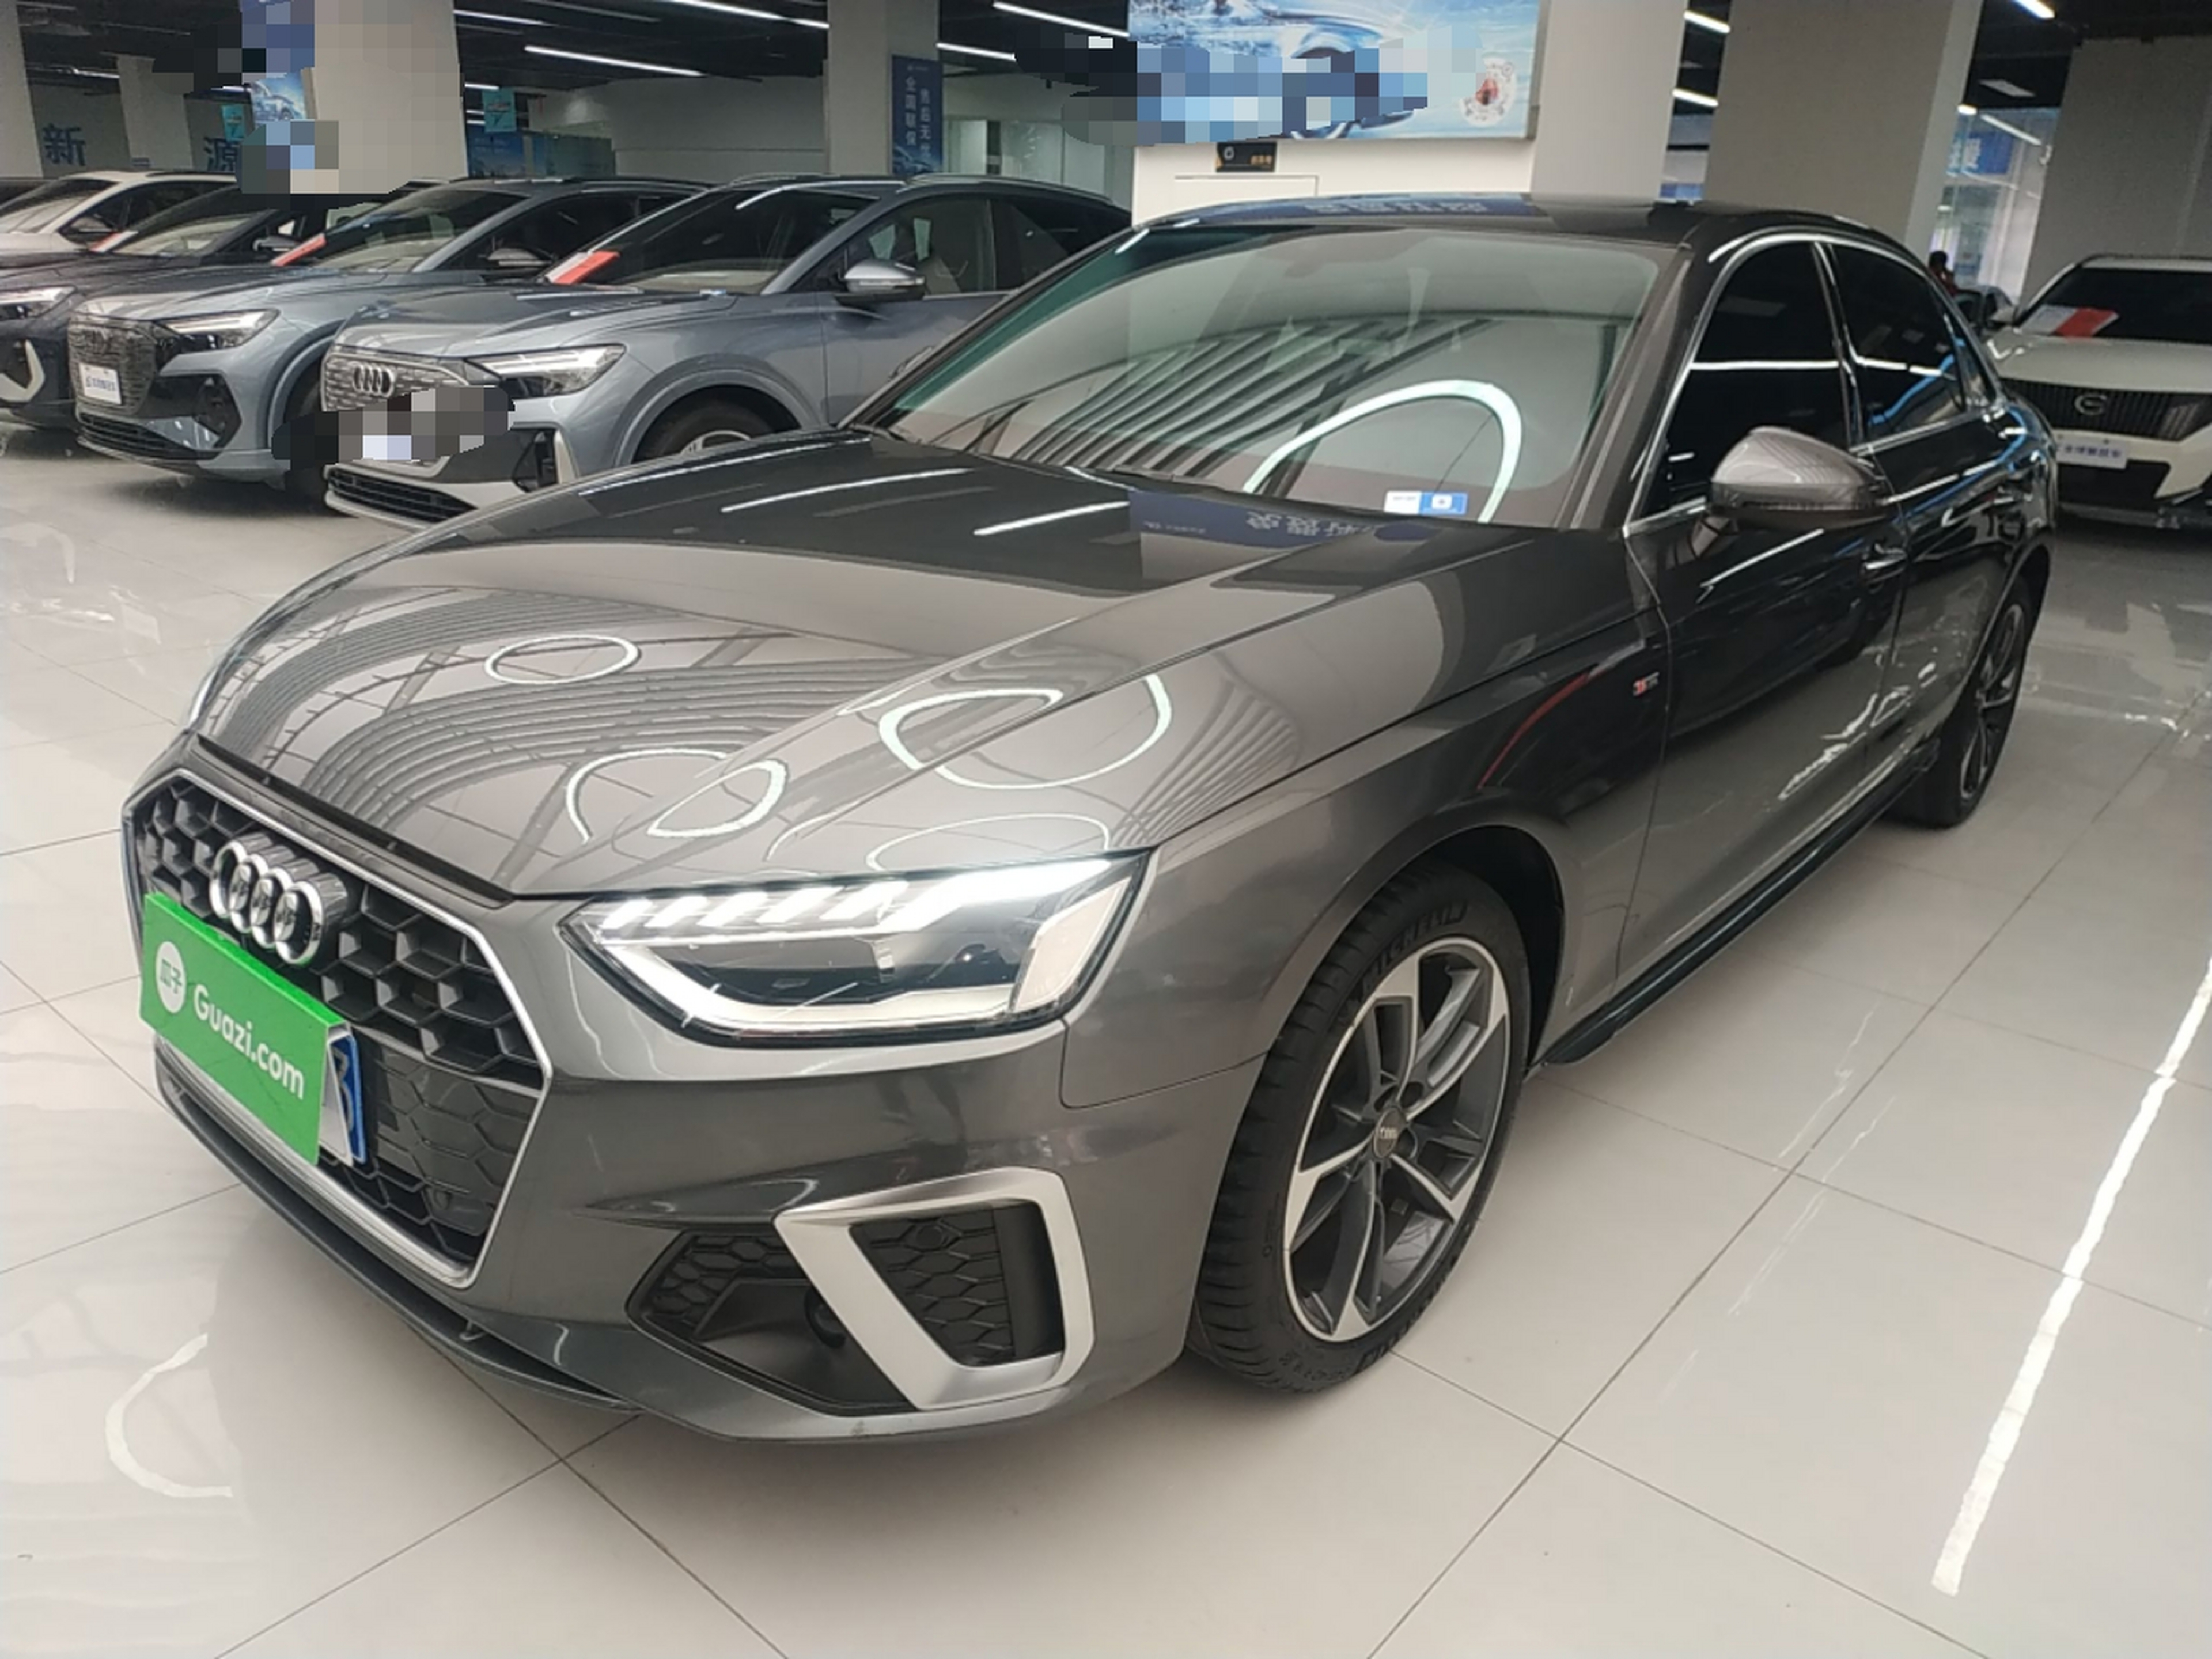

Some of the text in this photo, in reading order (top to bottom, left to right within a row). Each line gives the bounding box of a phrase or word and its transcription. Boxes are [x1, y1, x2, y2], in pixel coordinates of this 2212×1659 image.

[41, 122, 238, 172] 新 源
[193, 984, 305, 1100] Guazi.com
